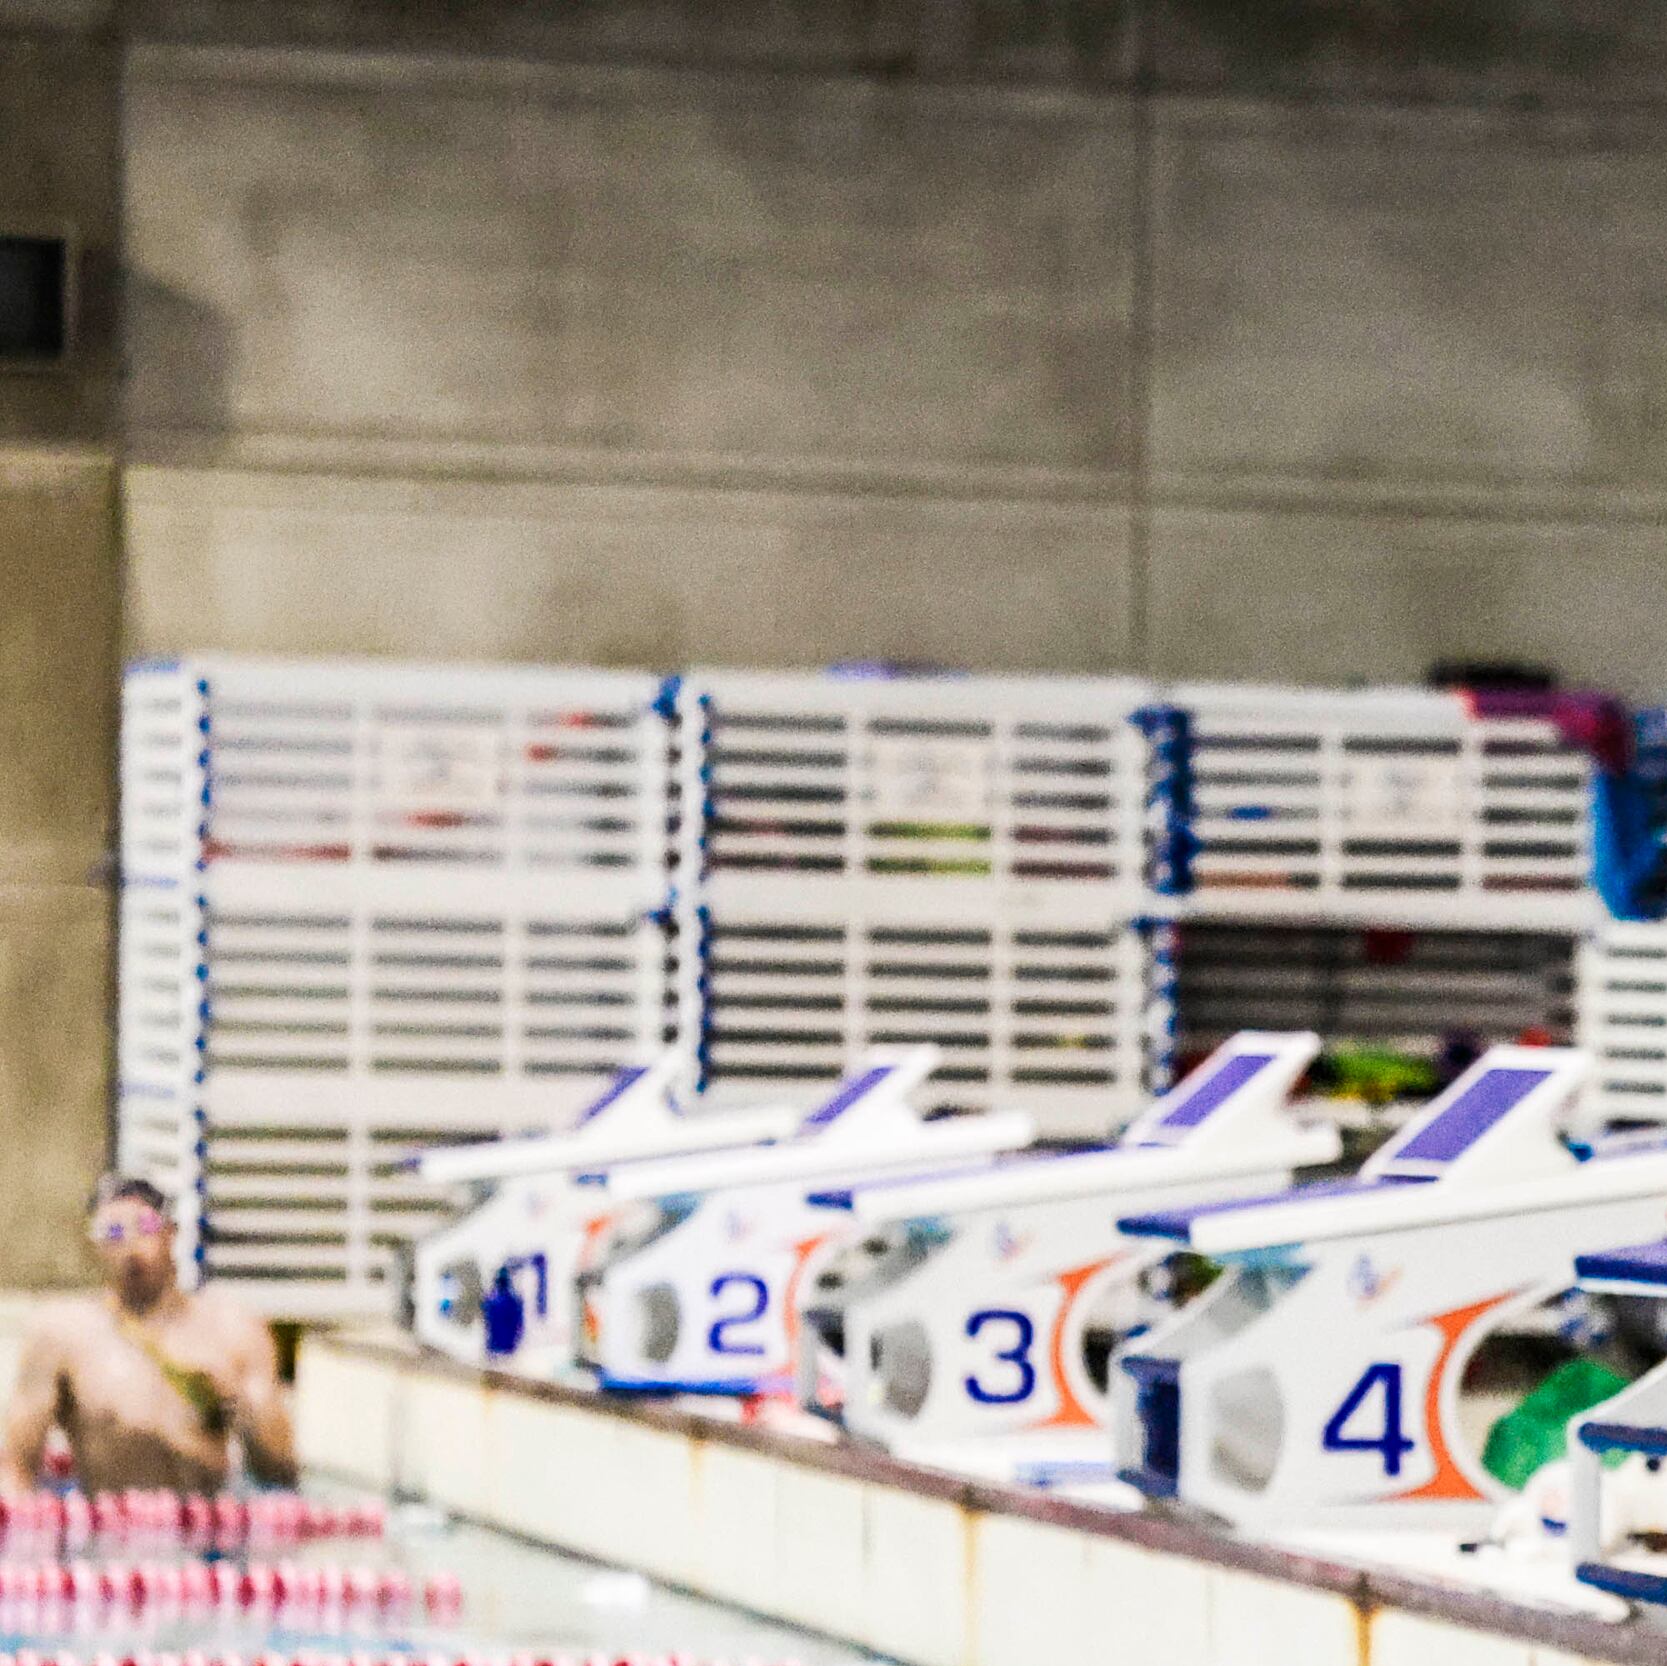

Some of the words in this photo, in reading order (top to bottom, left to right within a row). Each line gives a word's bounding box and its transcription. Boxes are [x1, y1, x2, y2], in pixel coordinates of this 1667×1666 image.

[708, 1271, 769, 1355] 2
[964, 1309, 1036, 1405] 3
[1321, 1362, 1416, 1478] 4
